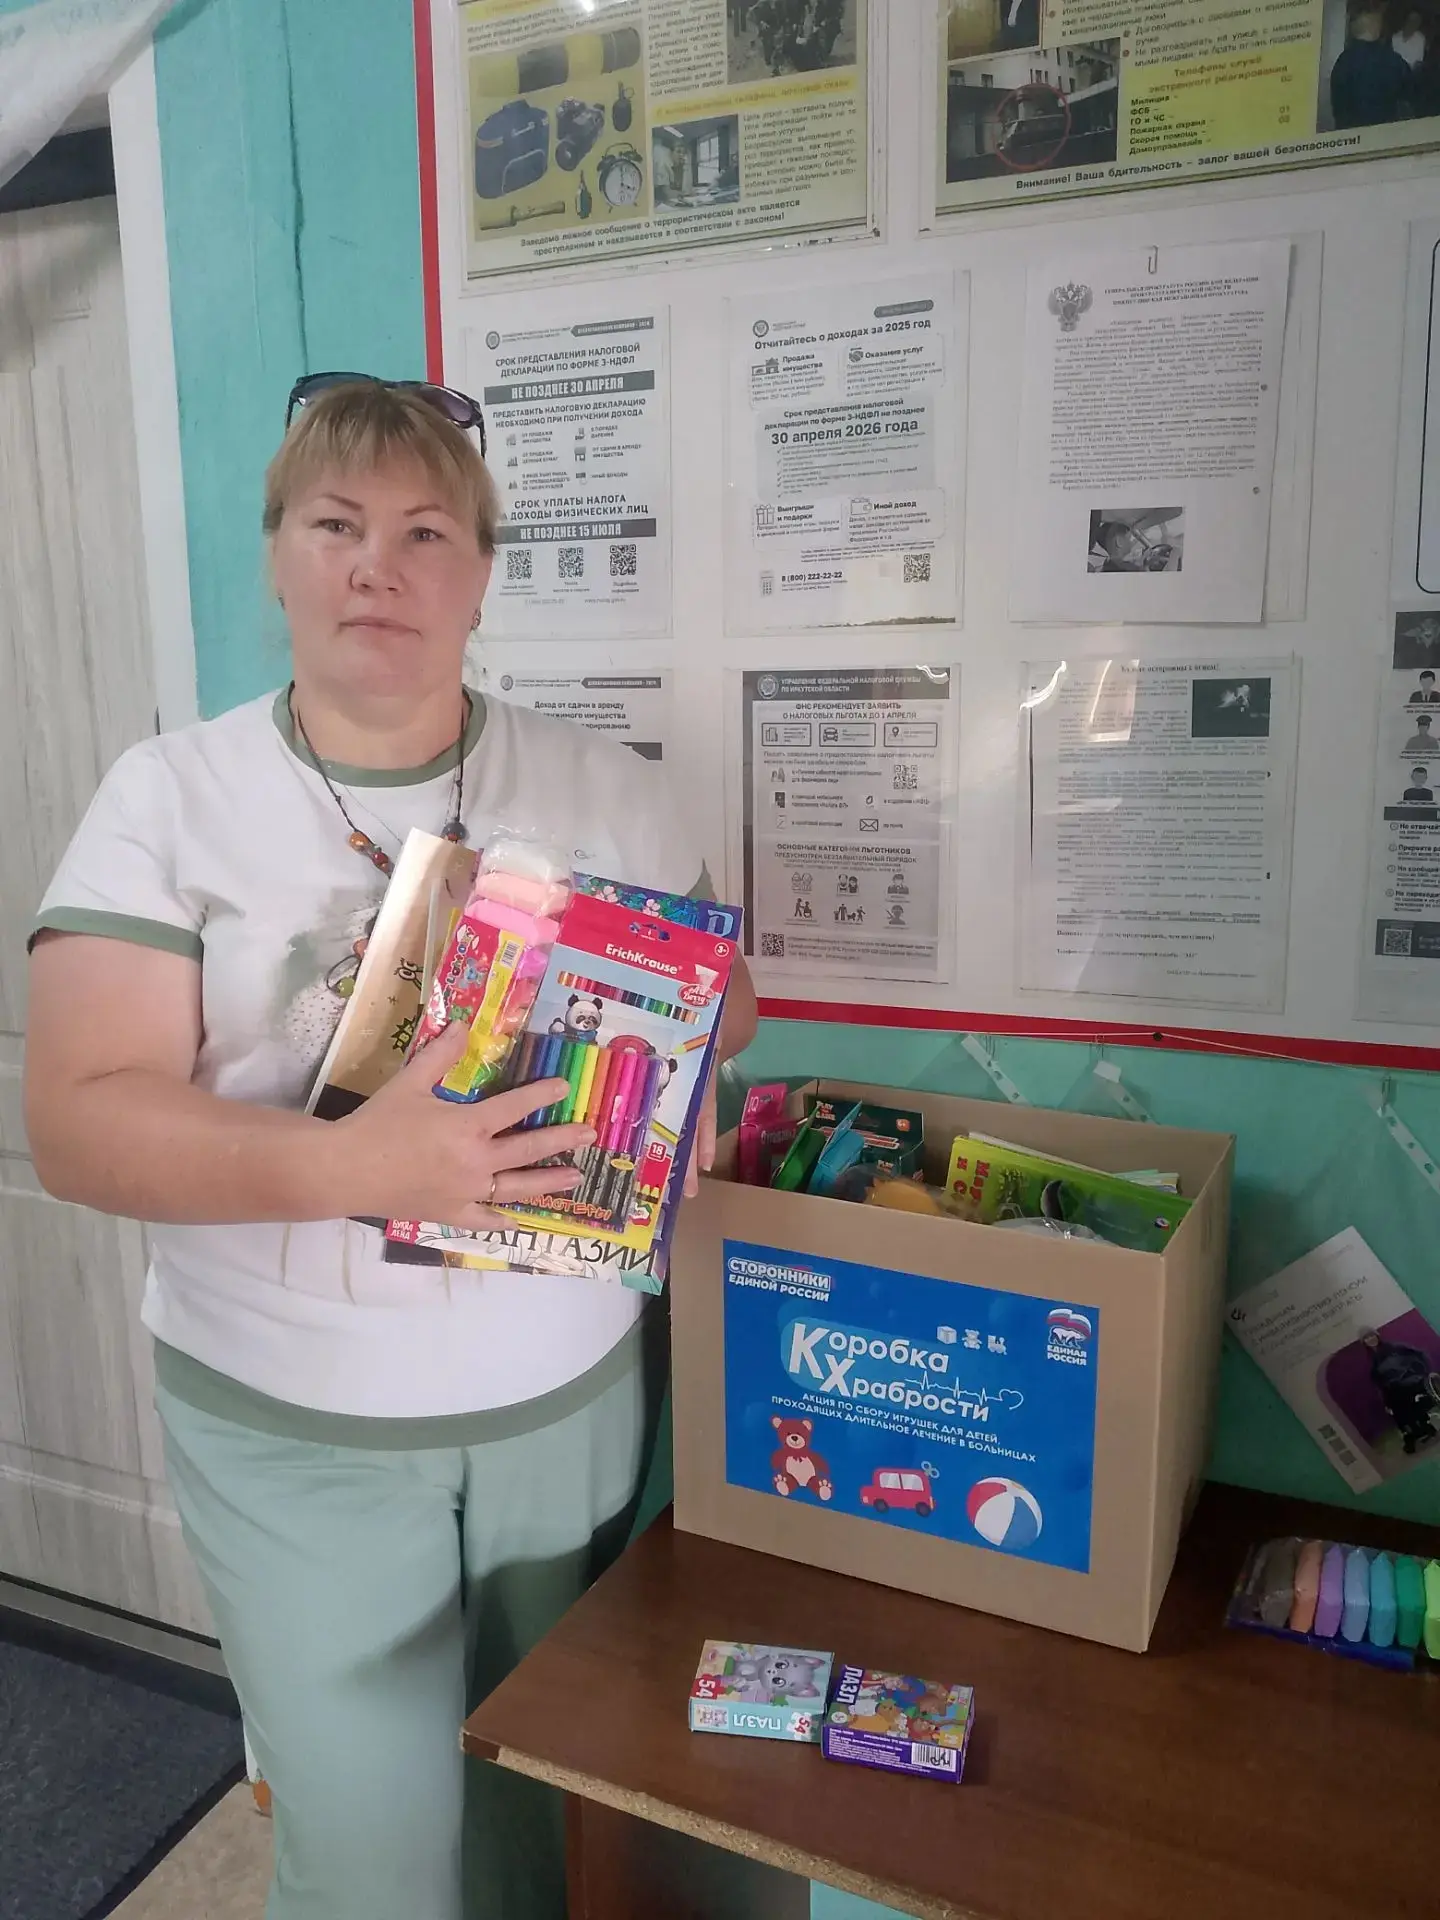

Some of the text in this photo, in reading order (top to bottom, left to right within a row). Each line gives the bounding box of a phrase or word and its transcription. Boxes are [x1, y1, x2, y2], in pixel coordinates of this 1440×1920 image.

[1131, 95, 1169, 105] Милиция
[1131, 106, 1149, 115] ФСБ
[1016, 135, 1360, 189] Внимание! Ваша бдительность залог вашей безопасности!
[521, 234, 559, 246] Заведомо
[595, 222, 641, 236] сообщение
[654, 209, 733, 229] террористическом
[737, 206, 756, 215] акте
[760, 200, 800, 212] является
[674, 220, 732, 236] соответствии
[744, 213, 784, 226] законом!
[755, 334, 816, 350] Отчитайтесь
[828, 328, 869, 340] доходах
[871, 326, 882, 335] за
[885, 322, 910, 333] 2025
[913, 320, 930, 330] год
[496, 344, 639, 367] СРОК ПРЕДСТАВЛЕНИЯ НАЛОГОВОЙ
[782, 353, 814, 363] Продажа
[866, 346, 923, 359] Оказание услуг
[501, 356, 634, 377] ДЕКЛАРАЦИИ ПО ФОРМЕ 3-НДФЛ
[783, 362, 823, 373] имущества
[512, 377, 623, 399] НЕ ПОЗДНЕЕ 30 АПРЕЛЯ
[493, 398, 646, 418] ПРЕДСТАВИТЬ НАЛОГОВУЮ ДЕКЛАРАЦИЮ
[784, 398, 903, 418] Срок представления налоговой
[496, 418, 545, 428] НЕОБХОДИМО
[564, 412, 609, 422] ПОЛУЧЕНИИ
[611, 409, 643, 418] ДОХОДА
[765, 406, 925, 431] декларации по форме 3-НДФЛ не позднее
[771, 421, 918, 445] 30 апреля 2026 года
[515, 495, 626, 508] СРОК УПЛАТЫ НАЛОГА
[778, 503, 814, 513] Выигрыши
[874, 501, 916, 510] Иной доход
[511, 505, 648, 520] ДОХОДЫ ФИЗИЧЕСКИХ ЛИЦ
[784, 513, 812, 521] подарки
[521, 524, 621, 539] НЕ ПОЗДНЕЕ 15 ИЮЛЯ
[788, 574, 805, 582] (800)
[808, 572, 842, 580] 222-22-22
[534, 702, 555, 710] Доход
[777, 843, 816, 851] ОСНОВНЫЕ
[862, 846, 910, 854] ЛЬГОТНИКОВ
[606, 943, 678, 975] ErichKrause
[652, 1144, 664, 1156] 18
[729, 1258, 830, 1289] СТОРОННИКИ
[729, 1274, 829, 1302] ЕДИНОЙ РОССИИ
[788, 1323, 949, 1379] Коробка
[1047, 1345, 1087, 1358] ЕДИНАЯ
[1047, 1352, 1087, 1366] РОССИЯ
[820, 1350, 989, 1422] Храбрости
[803, 1393, 1001, 1444] АКЦИЯ ПО СБОРУ ИГРУШЕК ДЛЯ ДЕТЕЙ,
[772, 1396, 843, 1421] ПРОХОДЯЩИХ
[845, 1411, 909, 1435] ДЛИТЕЛЬНОЕ
[912, 1425, 957, 1445] ЛЕЧЕНИЕ
[968, 1437, 1036, 1463] БОЛЬНИЦАХ
[698, 1678, 716, 1698] 54
[836, 1664, 863, 1704] ПАЗЛ
[732, 1712, 781, 1731] ПАЗЛ
